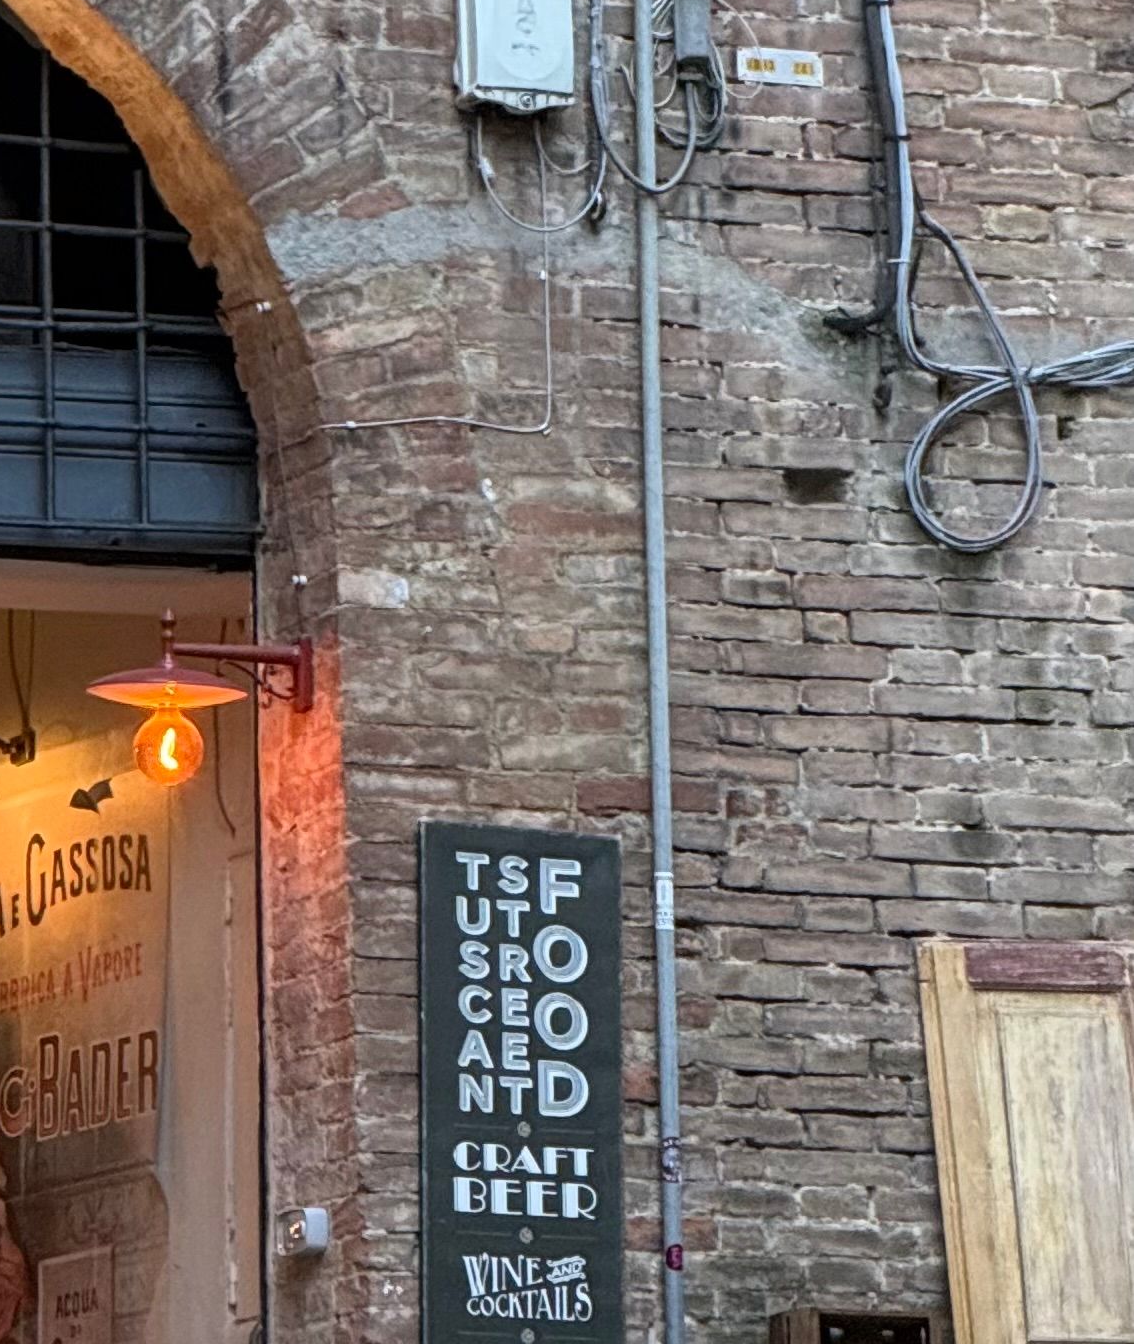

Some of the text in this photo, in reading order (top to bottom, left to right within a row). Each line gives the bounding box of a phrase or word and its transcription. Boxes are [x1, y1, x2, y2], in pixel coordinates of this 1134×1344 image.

[26, 833, 152, 927] GASSOSA
[78, 942, 142, 1003] VAPORE
[455, 851, 494, 1114] TUSCAN
[496, 855, 533, 1115] STREET
[532, 858, 590, 1118] FOOD
[37, 1030, 159, 1142] BADER
[453, 1141, 595, 1177] CRAFT
[453, 1176, 597, 1221] BEER
[55, 1287, 99, 1319] ACQUA
[462, 1252, 582, 1297] WINE AND
[466, 1282, 592, 1322] COCKTAILS
